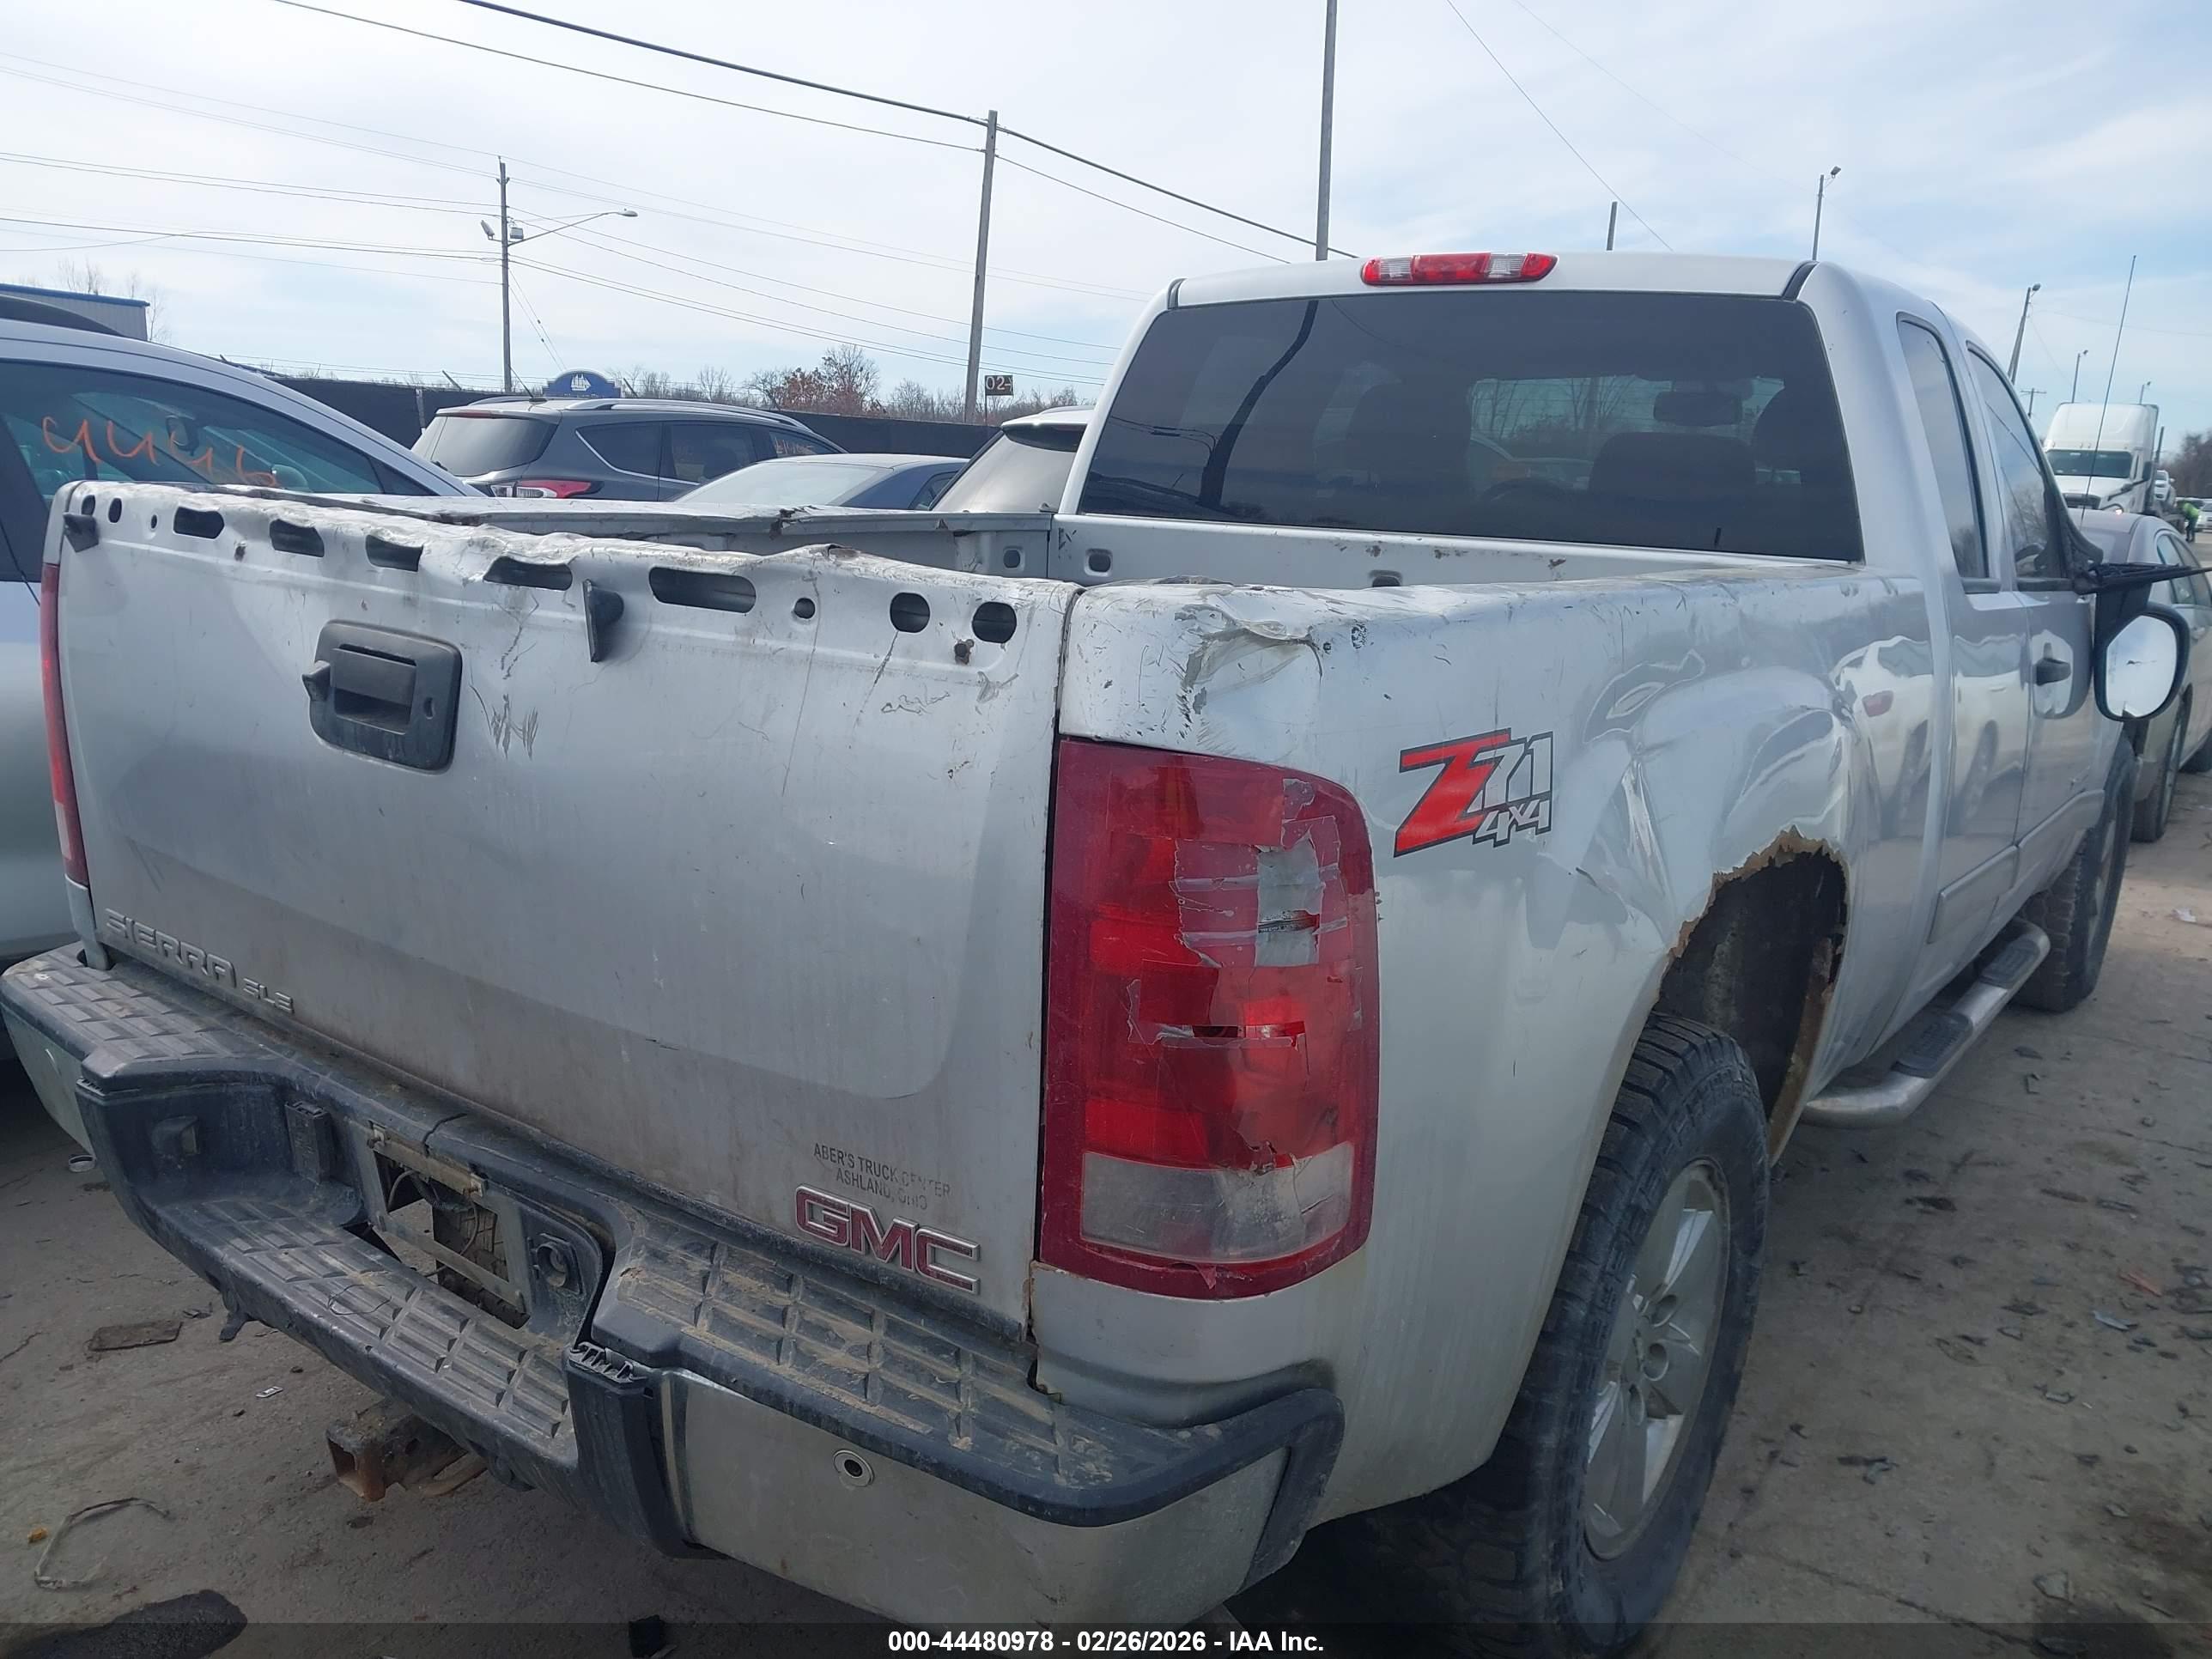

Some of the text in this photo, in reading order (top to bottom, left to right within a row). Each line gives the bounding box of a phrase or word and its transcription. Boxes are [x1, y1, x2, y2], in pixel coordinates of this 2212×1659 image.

[1394, 728, 1553, 857] Z71
[105, 908, 295, 1015] SIERRA SLE
[813, 1142, 855, 1170] ABER'S
[858, 1156, 899, 1182] TRUCK
[795, 1183, 981, 1295] GMC
